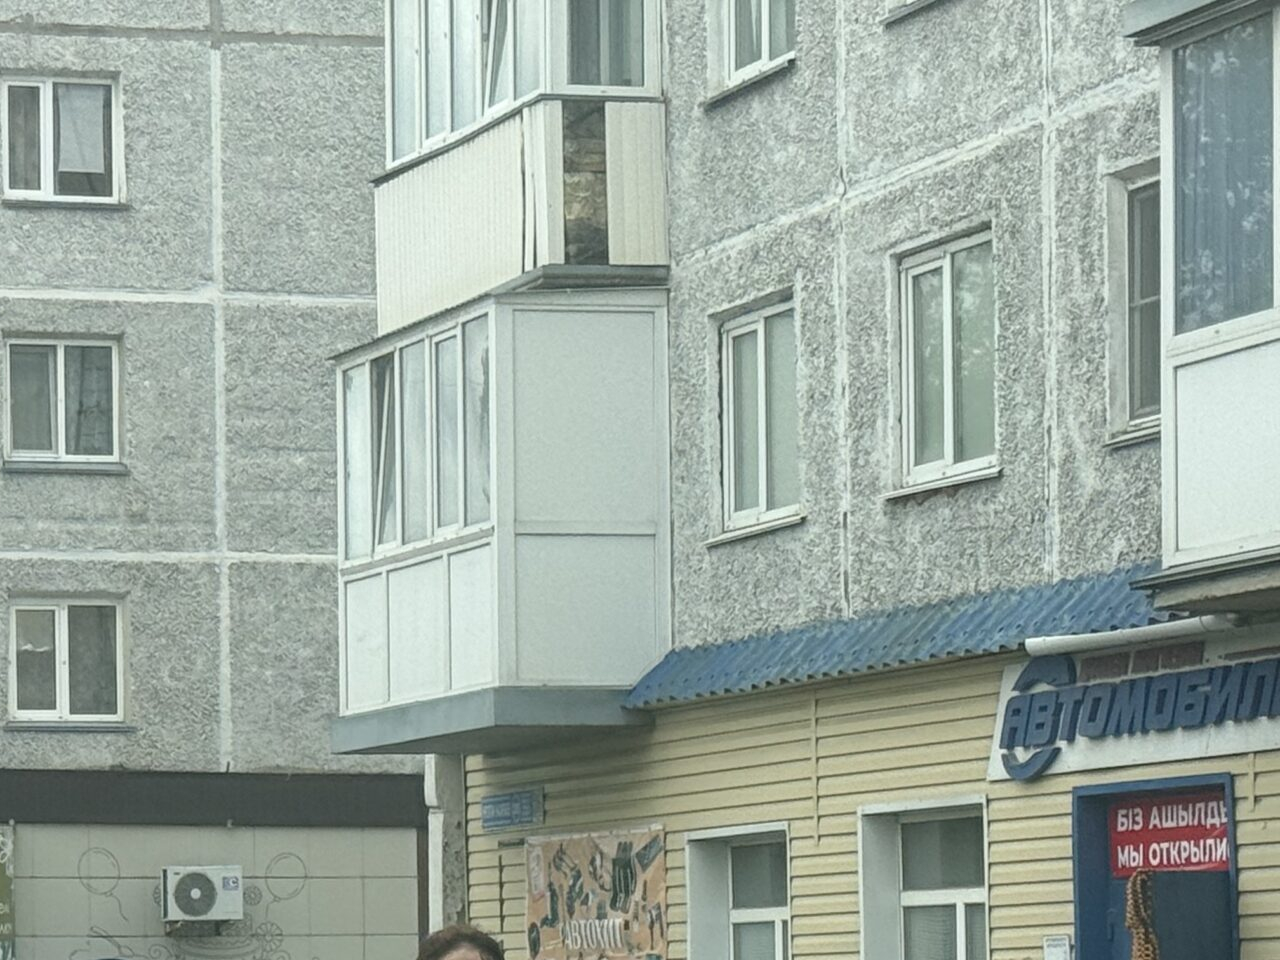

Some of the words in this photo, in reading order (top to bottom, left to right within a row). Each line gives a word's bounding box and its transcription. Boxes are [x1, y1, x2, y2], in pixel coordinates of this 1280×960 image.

[999, 657, 1280, 749] АВТОМОБИЛ
[1116, 808, 1143, 832] БІЗ
[1116, 843, 1143, 868] МЫ
[1148, 837, 1231, 867] ОТКРЫЛИ
